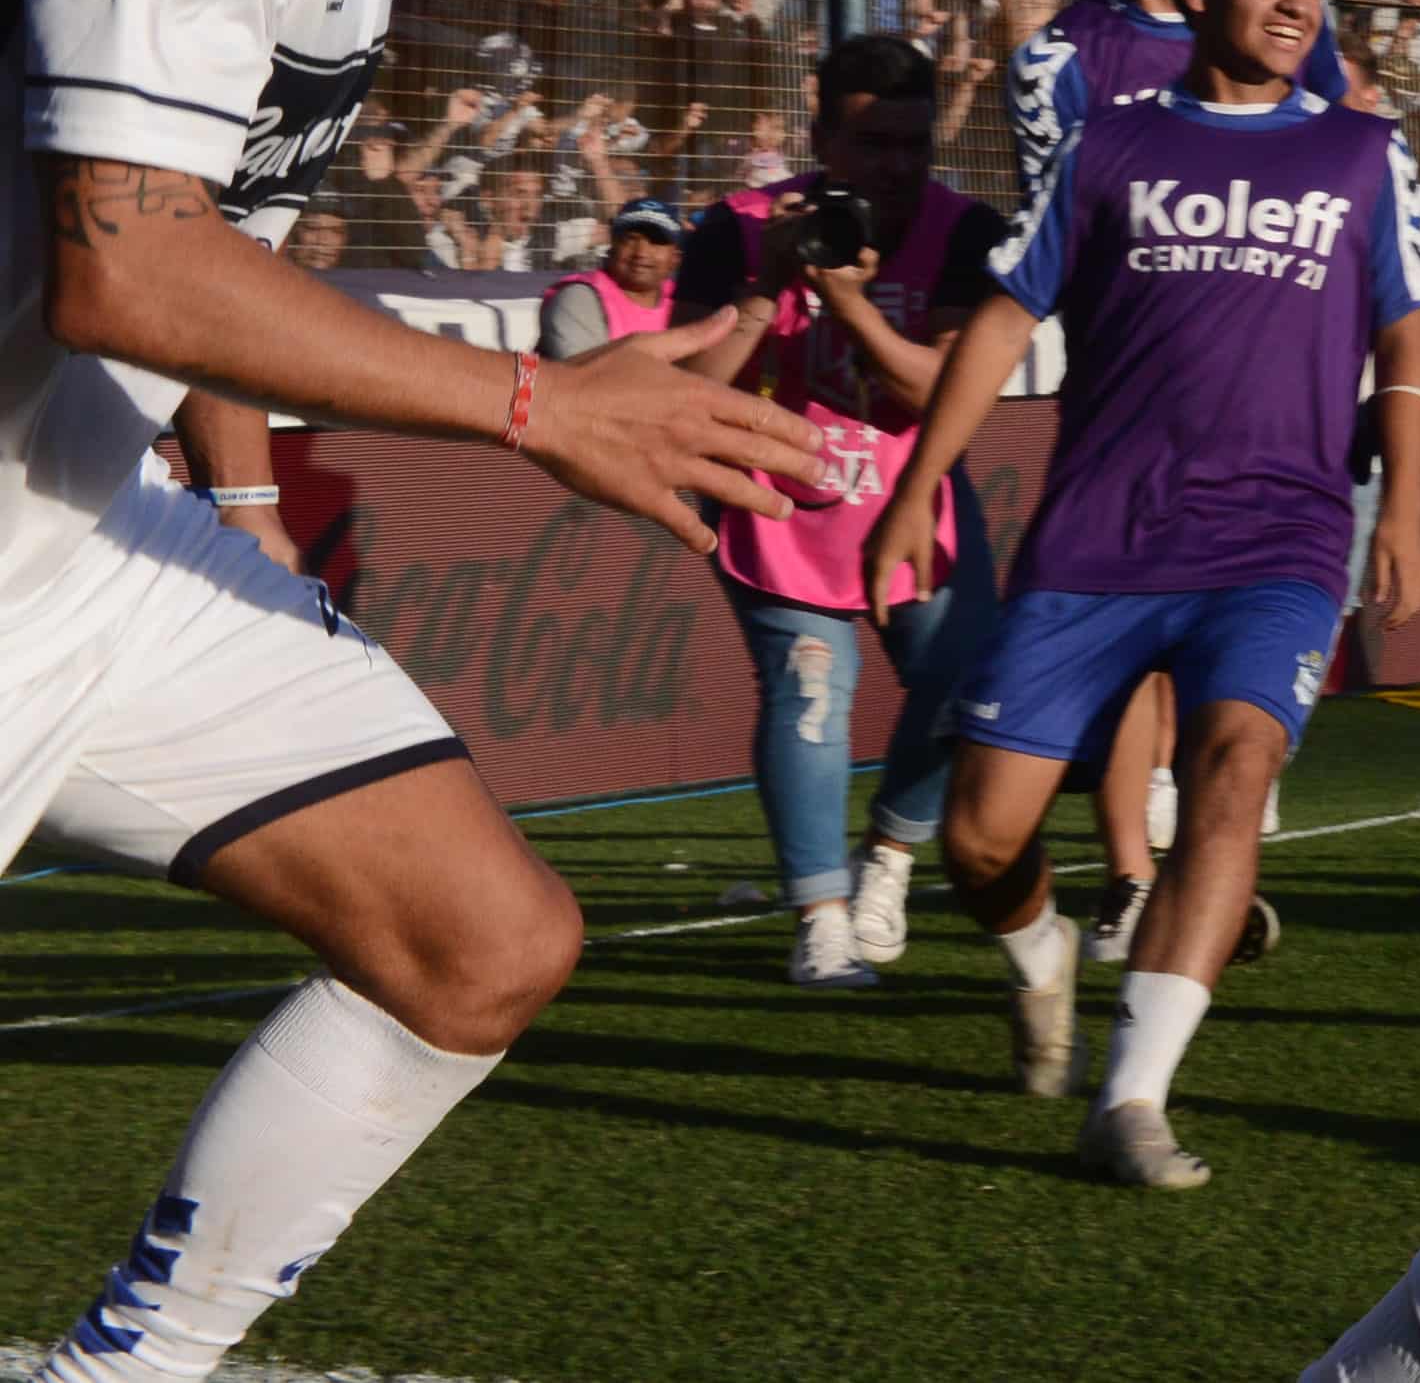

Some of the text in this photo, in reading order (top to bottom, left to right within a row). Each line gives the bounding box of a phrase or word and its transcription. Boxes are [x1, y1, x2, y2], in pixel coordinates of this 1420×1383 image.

[1128, 179, 1352, 257] Koleff
[1127, 244, 1329, 291] CENTURY 21
